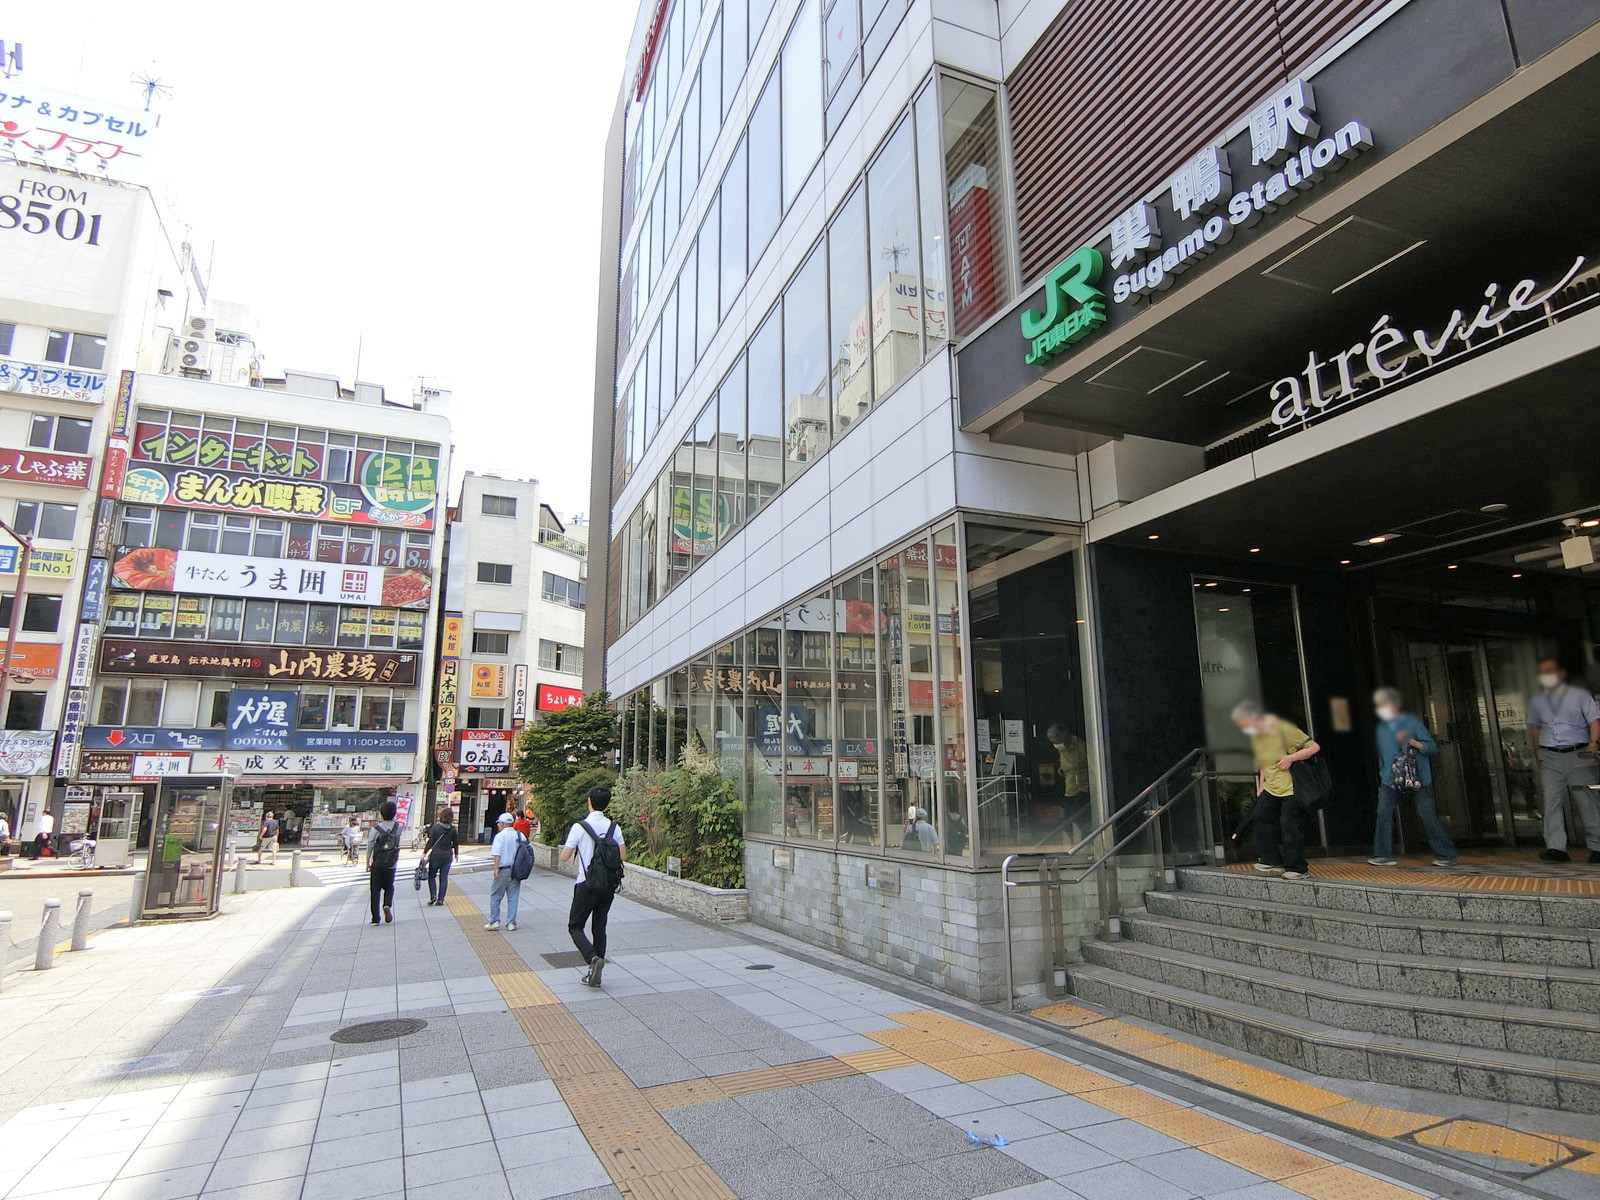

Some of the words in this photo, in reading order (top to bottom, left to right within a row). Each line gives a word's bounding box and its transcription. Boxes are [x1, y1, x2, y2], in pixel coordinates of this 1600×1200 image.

[1110, 77, 1319, 270] 巣鴨駅
[18, 178, 88, 206] FROM
[1112, 216, 1232, 304] Sugamo
[1228, 119, 1370, 226] Station
[1019, 246, 1105, 340] JR
[1024, 301, 1106, 366] JR東日本
[1269, 256, 1586, 427] atrévie
[142, 431, 319, 476] インターネット
[16, 454, 88, 481] しゃぶ葉
[374, 456, 433, 480] 24
[175, 472, 326, 516] まんが喫茶
[334, 498, 362, 514] 5F
[85, 560, 103, 603] 大戸屋
[185, 565, 231, 582] 牛たん
[339, 593, 367, 601] UMAI
[268, 649, 377, 681] 山内農場
[400, 655, 414, 663] 3F
[231, 695, 289, 730] 大戸屋
[129, 733, 155, 745] 入口
[188, 735, 204, 745] 2F
[233, 737, 283, 747] OOTOYA
[306, 737, 342, 747] 営業時間
[347, 738, 374, 746] 11:00
[379, 739, 406, 747] 23:00
[212, 753, 230, 771] 本
[244, 754, 369, 772] 成文堂書店
[465, 749, 506, 764] 日高屋
